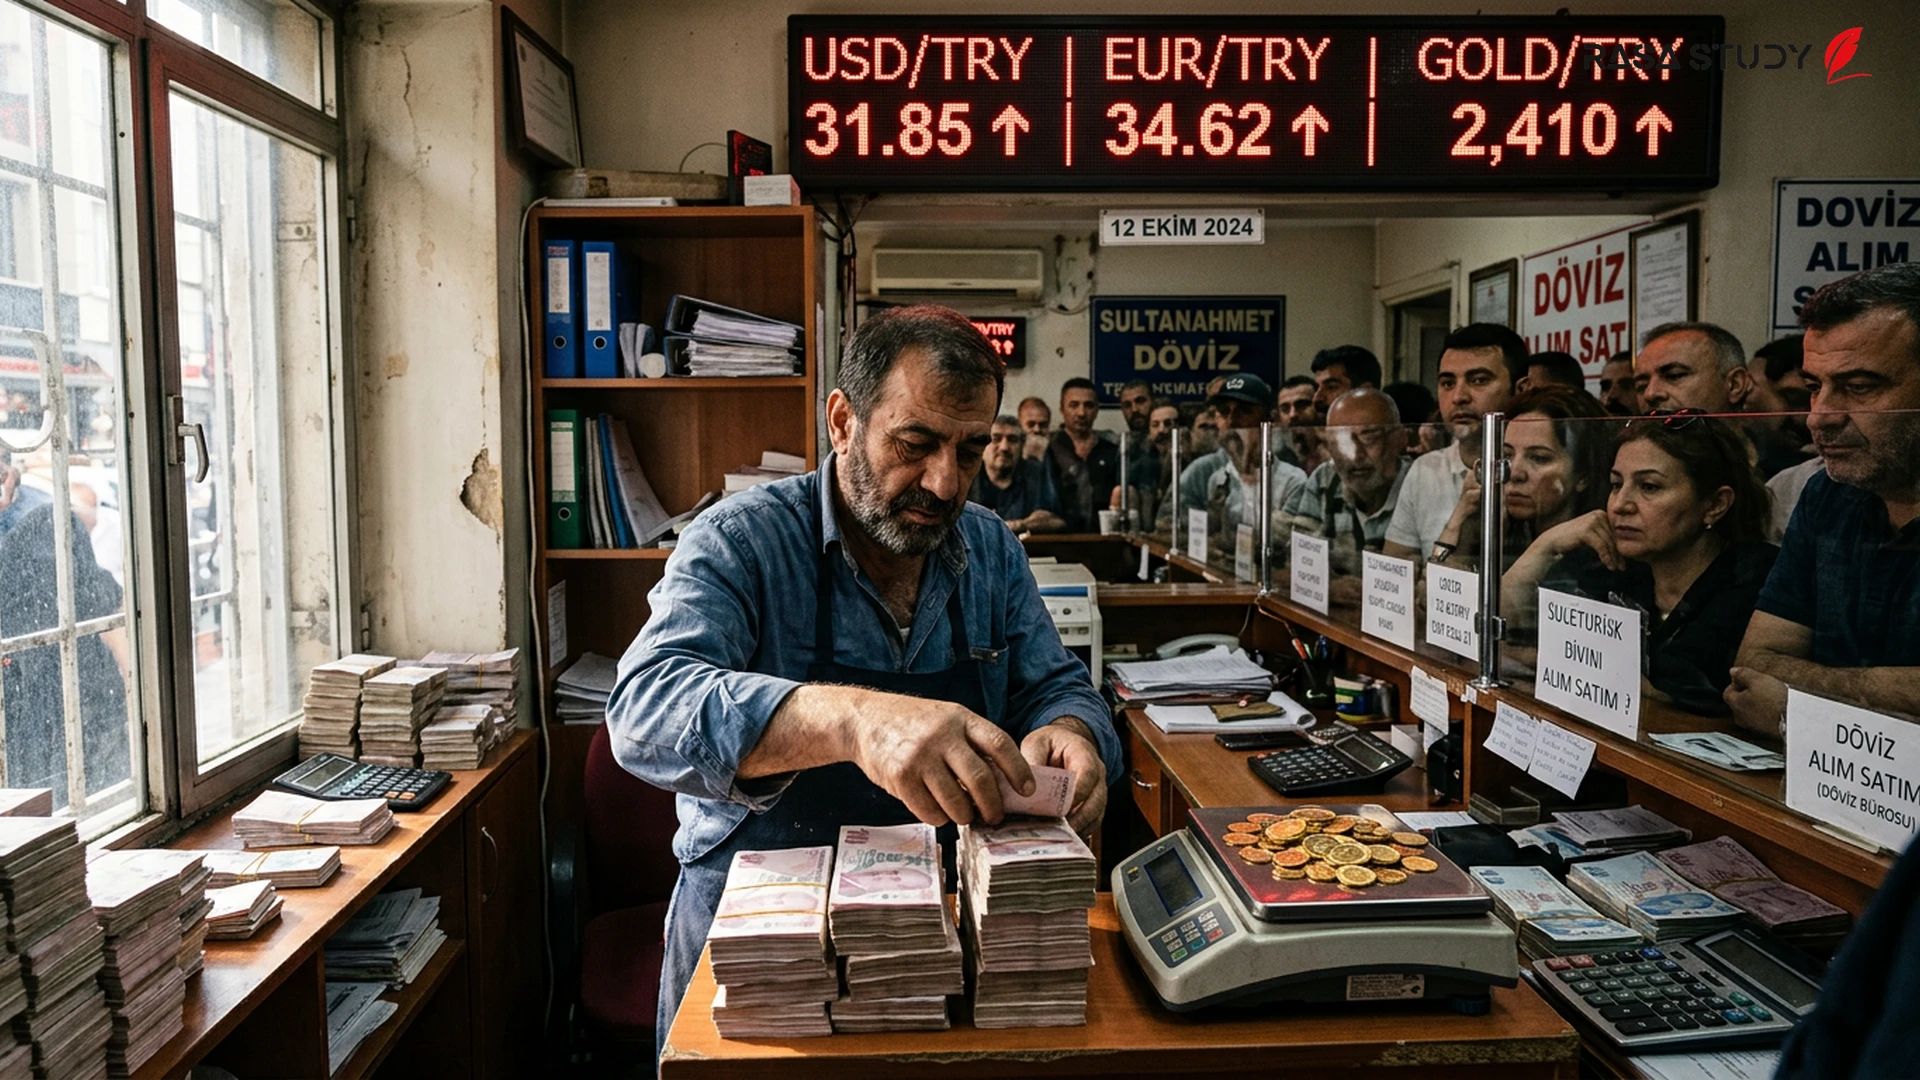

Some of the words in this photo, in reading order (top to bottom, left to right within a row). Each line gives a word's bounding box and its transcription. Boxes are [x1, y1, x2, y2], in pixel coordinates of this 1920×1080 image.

[804, 35, 1034, 90] USD/TRY
[1104, 35, 1332, 90] EUR/TRY
[1417, 34, 1685, 90] GOLD/TRY
[804, 102, 973, 157] 31.85
[1105, 102, 1273, 157] 34.62
[1450, 102, 1618, 167] 2,410
[1110, 218, 1136, 237] 12
[1142, 214, 1197, 236] EKİM
[1203, 217, 1254, 236] 2024
[1805, 241, 1910, 272] ALIM
[1533, 244, 1625, 317] DÖVİZ
[1099, 308, 1275, 333] SULTANAHMET
[1133, 338, 1241, 371] DÖVİZ
[1542, 667, 1572, 694] ALIM
[1575, 677, 1618, 711] SATIM
[1808, 750, 1855, 783] ALIM
[1860, 766, 1920, 807] SATIM
